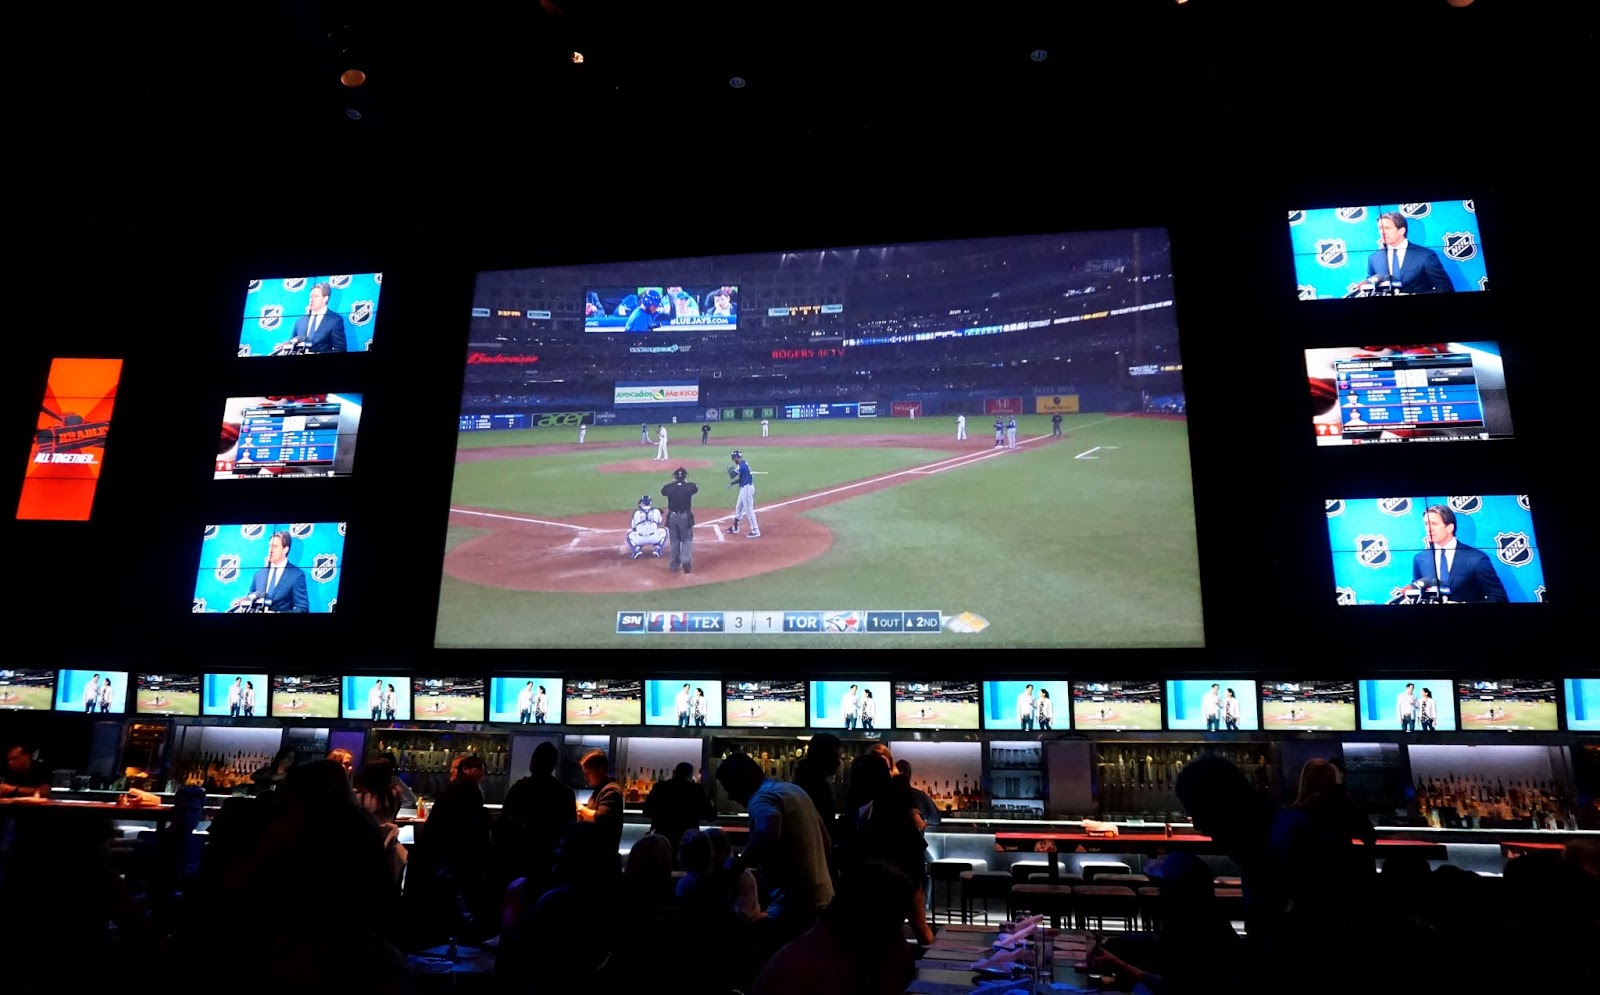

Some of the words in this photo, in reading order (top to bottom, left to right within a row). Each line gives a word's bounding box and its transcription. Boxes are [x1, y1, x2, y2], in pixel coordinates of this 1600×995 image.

[467, 352, 538, 364] Budweiser
[772, 349, 814, 359] ROGERS
[616, 390, 653, 398] Avocados
[666, 389, 698, 397] Mexico
[538, 412, 590, 427] acer
[34, 453, 50, 463] ALL
[622, 615, 642, 625] SN
[693, 616, 720, 628] TEX
[734, 616, 743, 628] 3
[766, 616, 772, 627] 1
[787, 616, 817, 628] TOR
[880, 619, 900, 627] OUT
[916, 616, 938, 627] 2ND
